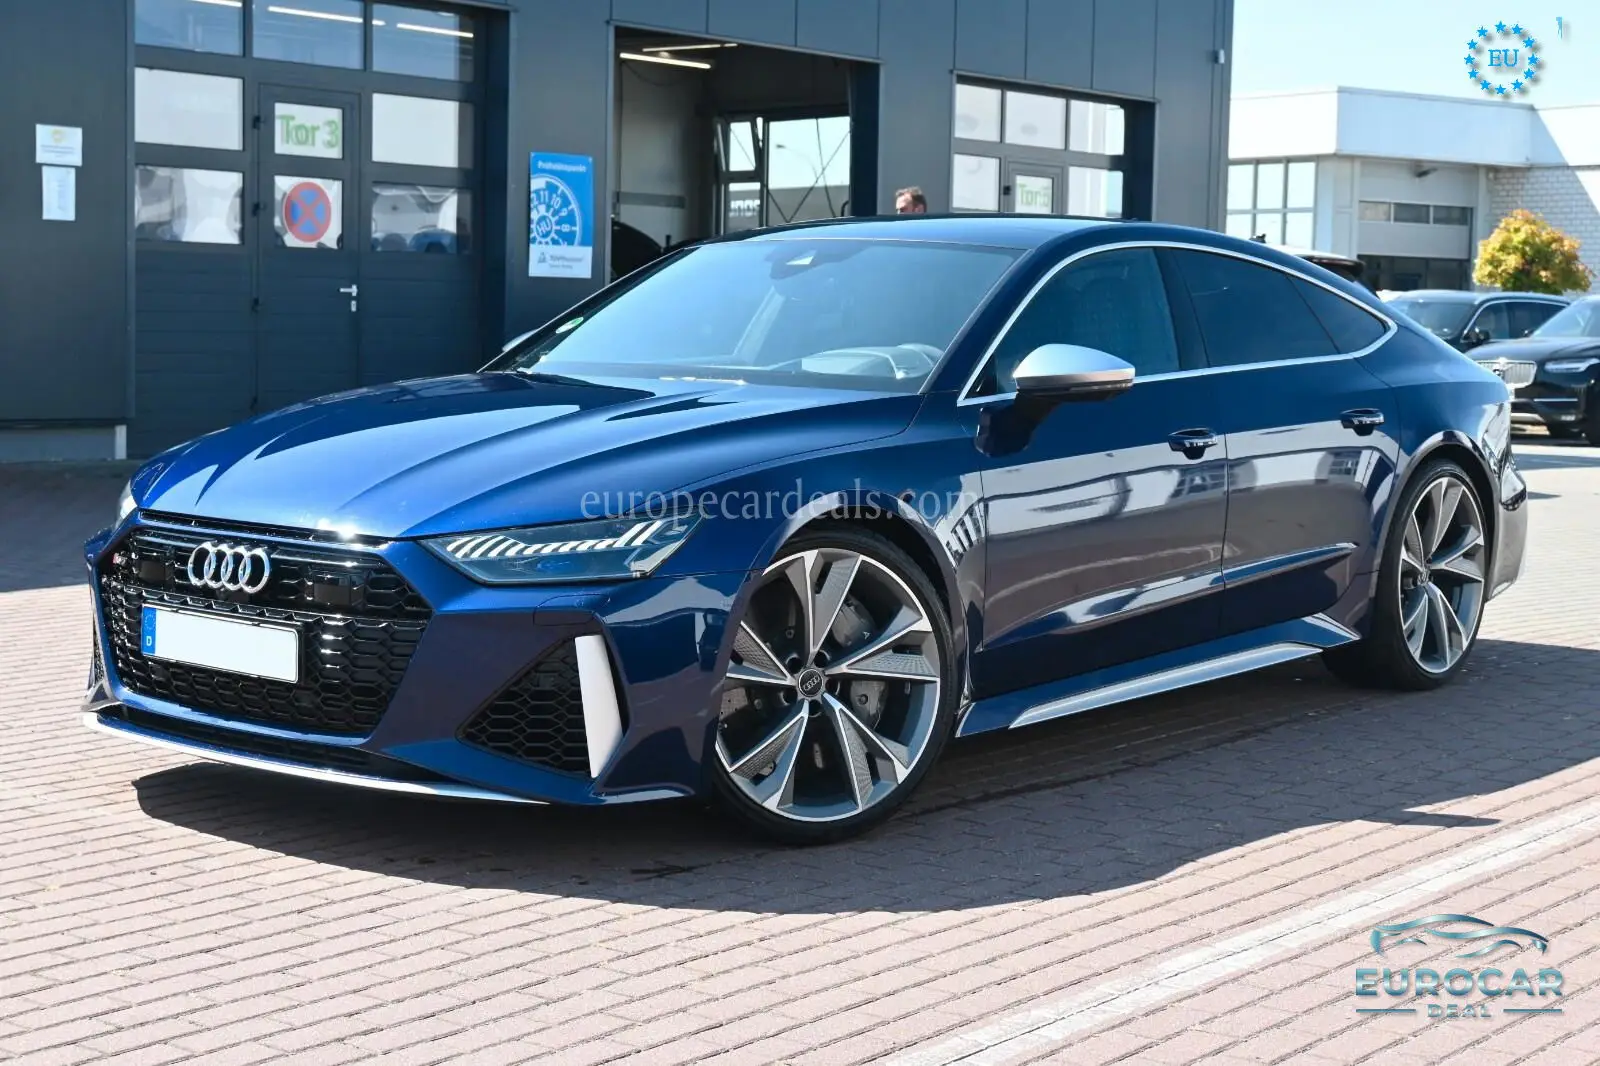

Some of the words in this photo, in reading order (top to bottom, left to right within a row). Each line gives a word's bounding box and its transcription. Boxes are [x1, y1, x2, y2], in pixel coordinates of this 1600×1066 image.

[275, 114, 320, 148] Tor
[322, 119, 340, 150] 3
[1018, 183, 1041, 206] Tor
[536, 217, 552, 237] HU
[145, 635, 153, 647] D
